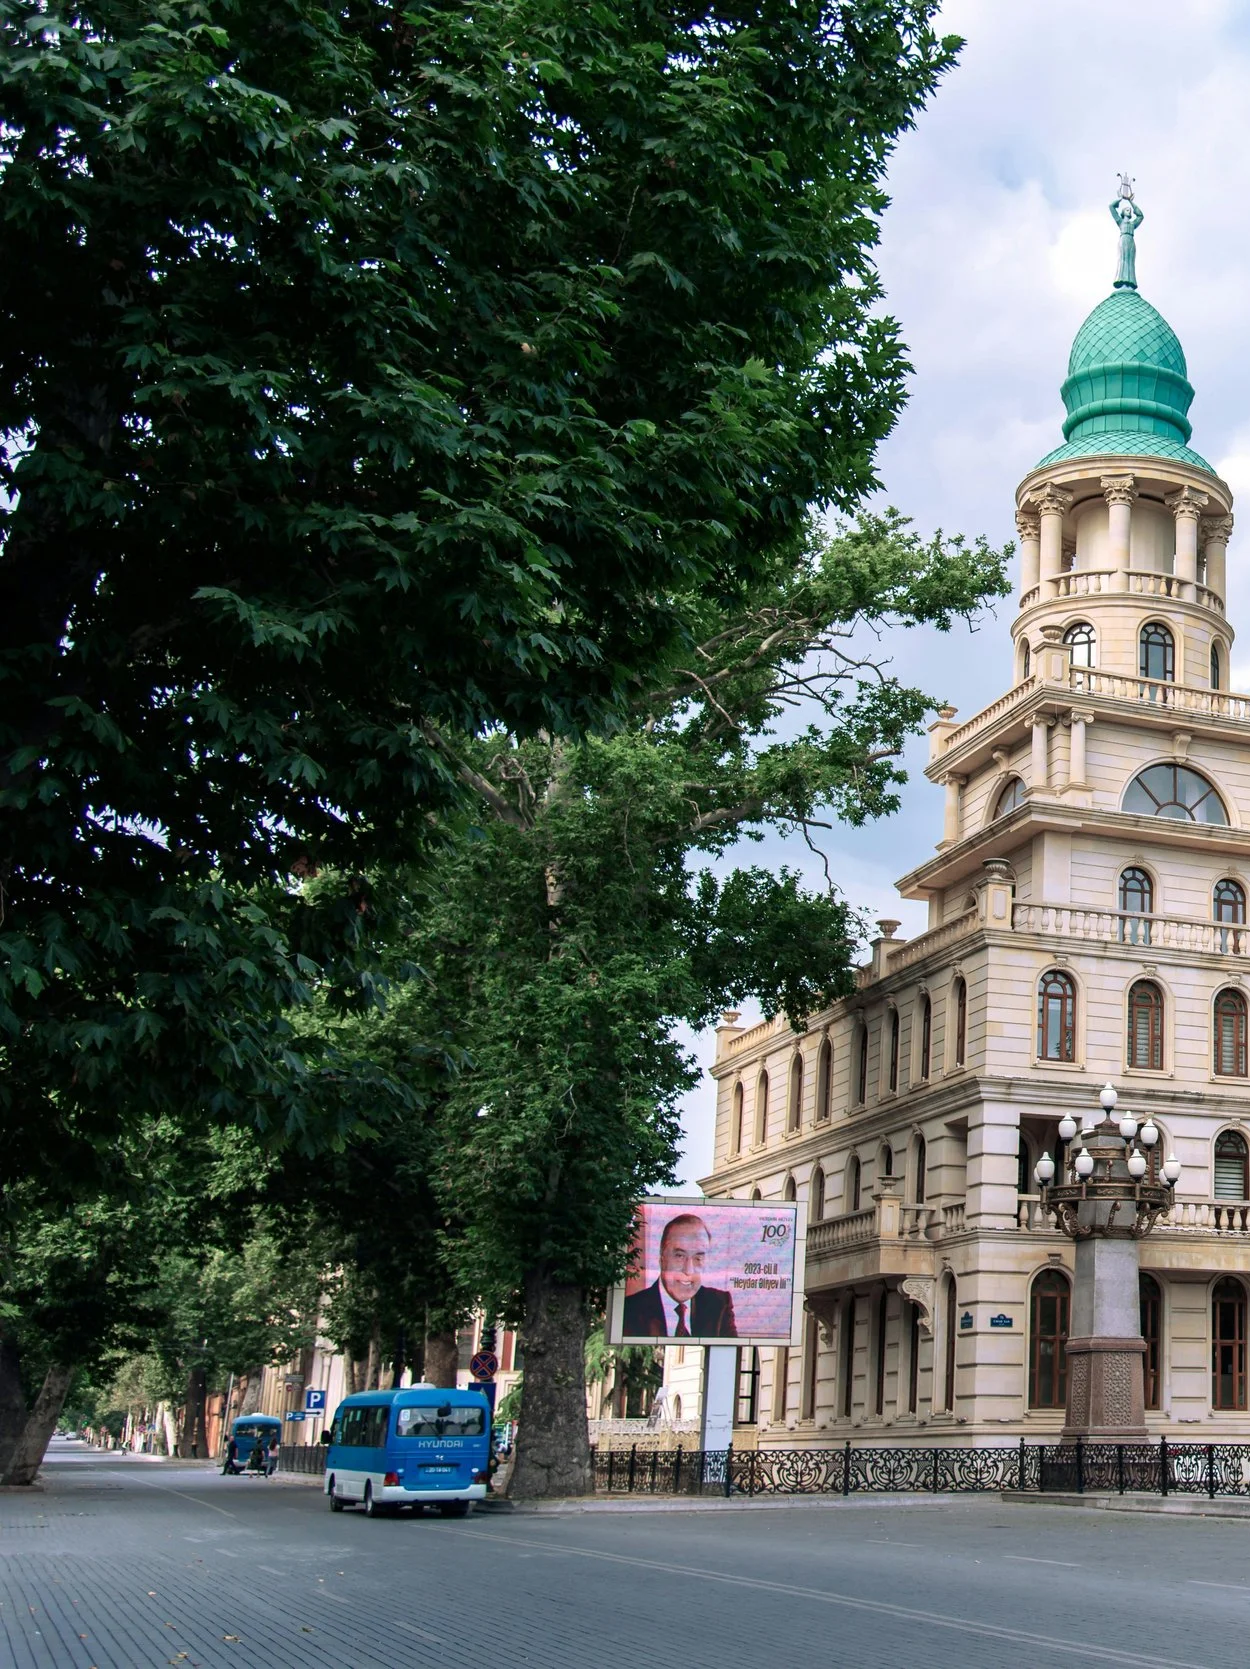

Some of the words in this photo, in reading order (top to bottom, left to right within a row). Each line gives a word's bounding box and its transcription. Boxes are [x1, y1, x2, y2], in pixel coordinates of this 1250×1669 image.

[760, 1224, 787, 1242] 100
[310, 1392, 322, 1408] P
[286, 1412, 294, 1420] P
[418, 1440, 464, 1448] HYUNDAI
